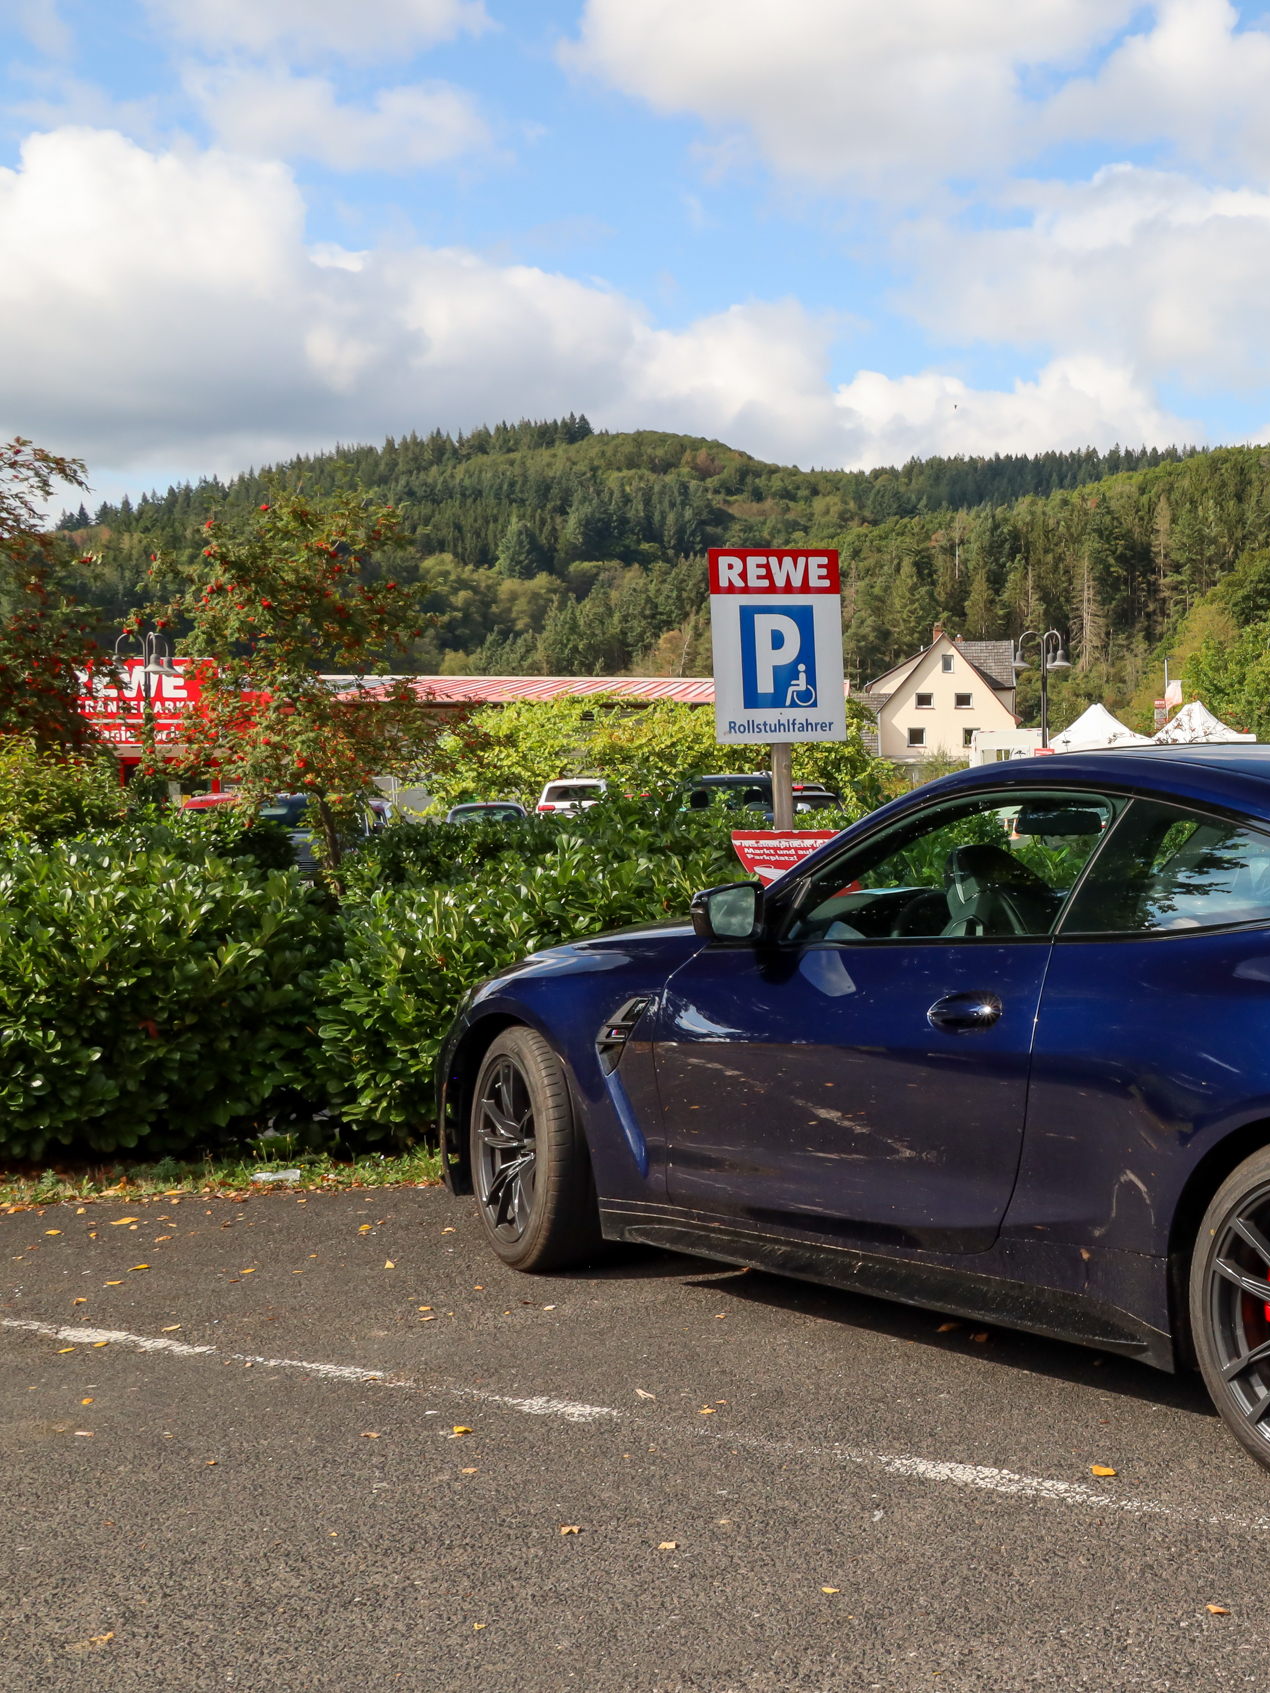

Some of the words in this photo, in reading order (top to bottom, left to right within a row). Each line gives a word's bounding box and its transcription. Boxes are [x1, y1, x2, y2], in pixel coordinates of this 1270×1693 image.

[718, 556, 831, 588] REWE
[753, 613, 801, 694] P
[728, 718, 834, 735] Rollstuhlfahrer
[744, 847, 776, 855] Markt
[746, 853, 799, 861] Parkplatz!
